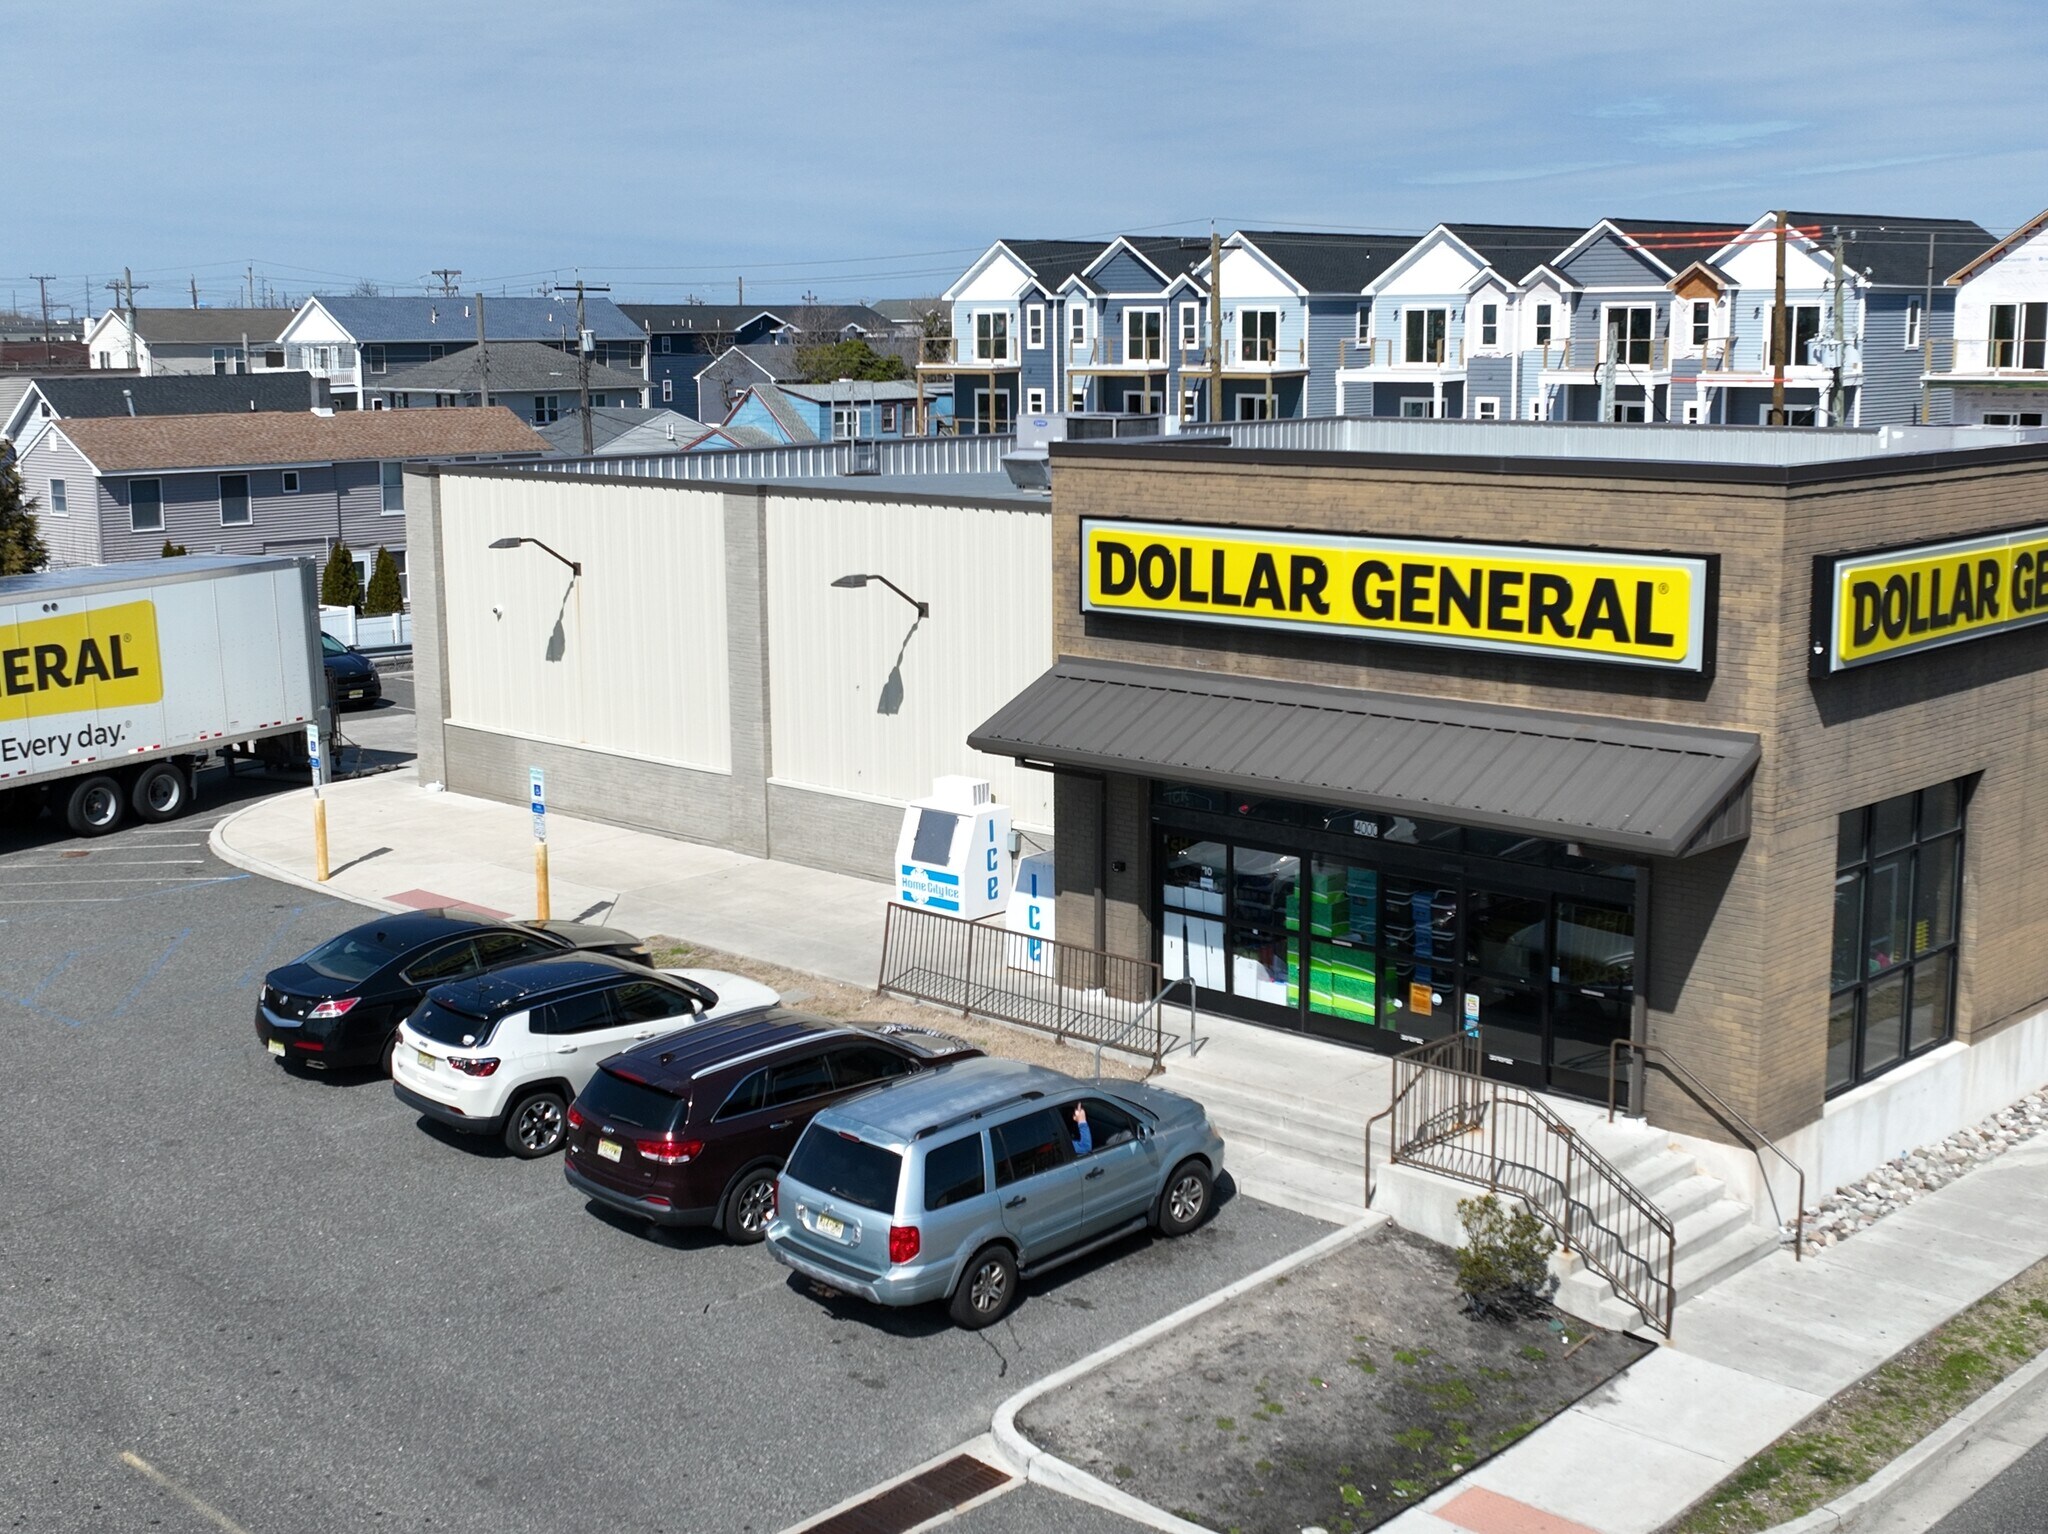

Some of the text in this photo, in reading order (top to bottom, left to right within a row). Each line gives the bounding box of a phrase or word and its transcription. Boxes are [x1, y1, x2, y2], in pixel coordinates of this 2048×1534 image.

[1096, 540, 1331, 615] DOLLAR
[1852, 558, 2000, 647] DOLLAR
[0, 634, 139, 697] ERAL
[1, 723, 126, 762] Every day.
[1354, 821, 1378, 836] 4000
[901, 877, 959, 898] Home City Ice
